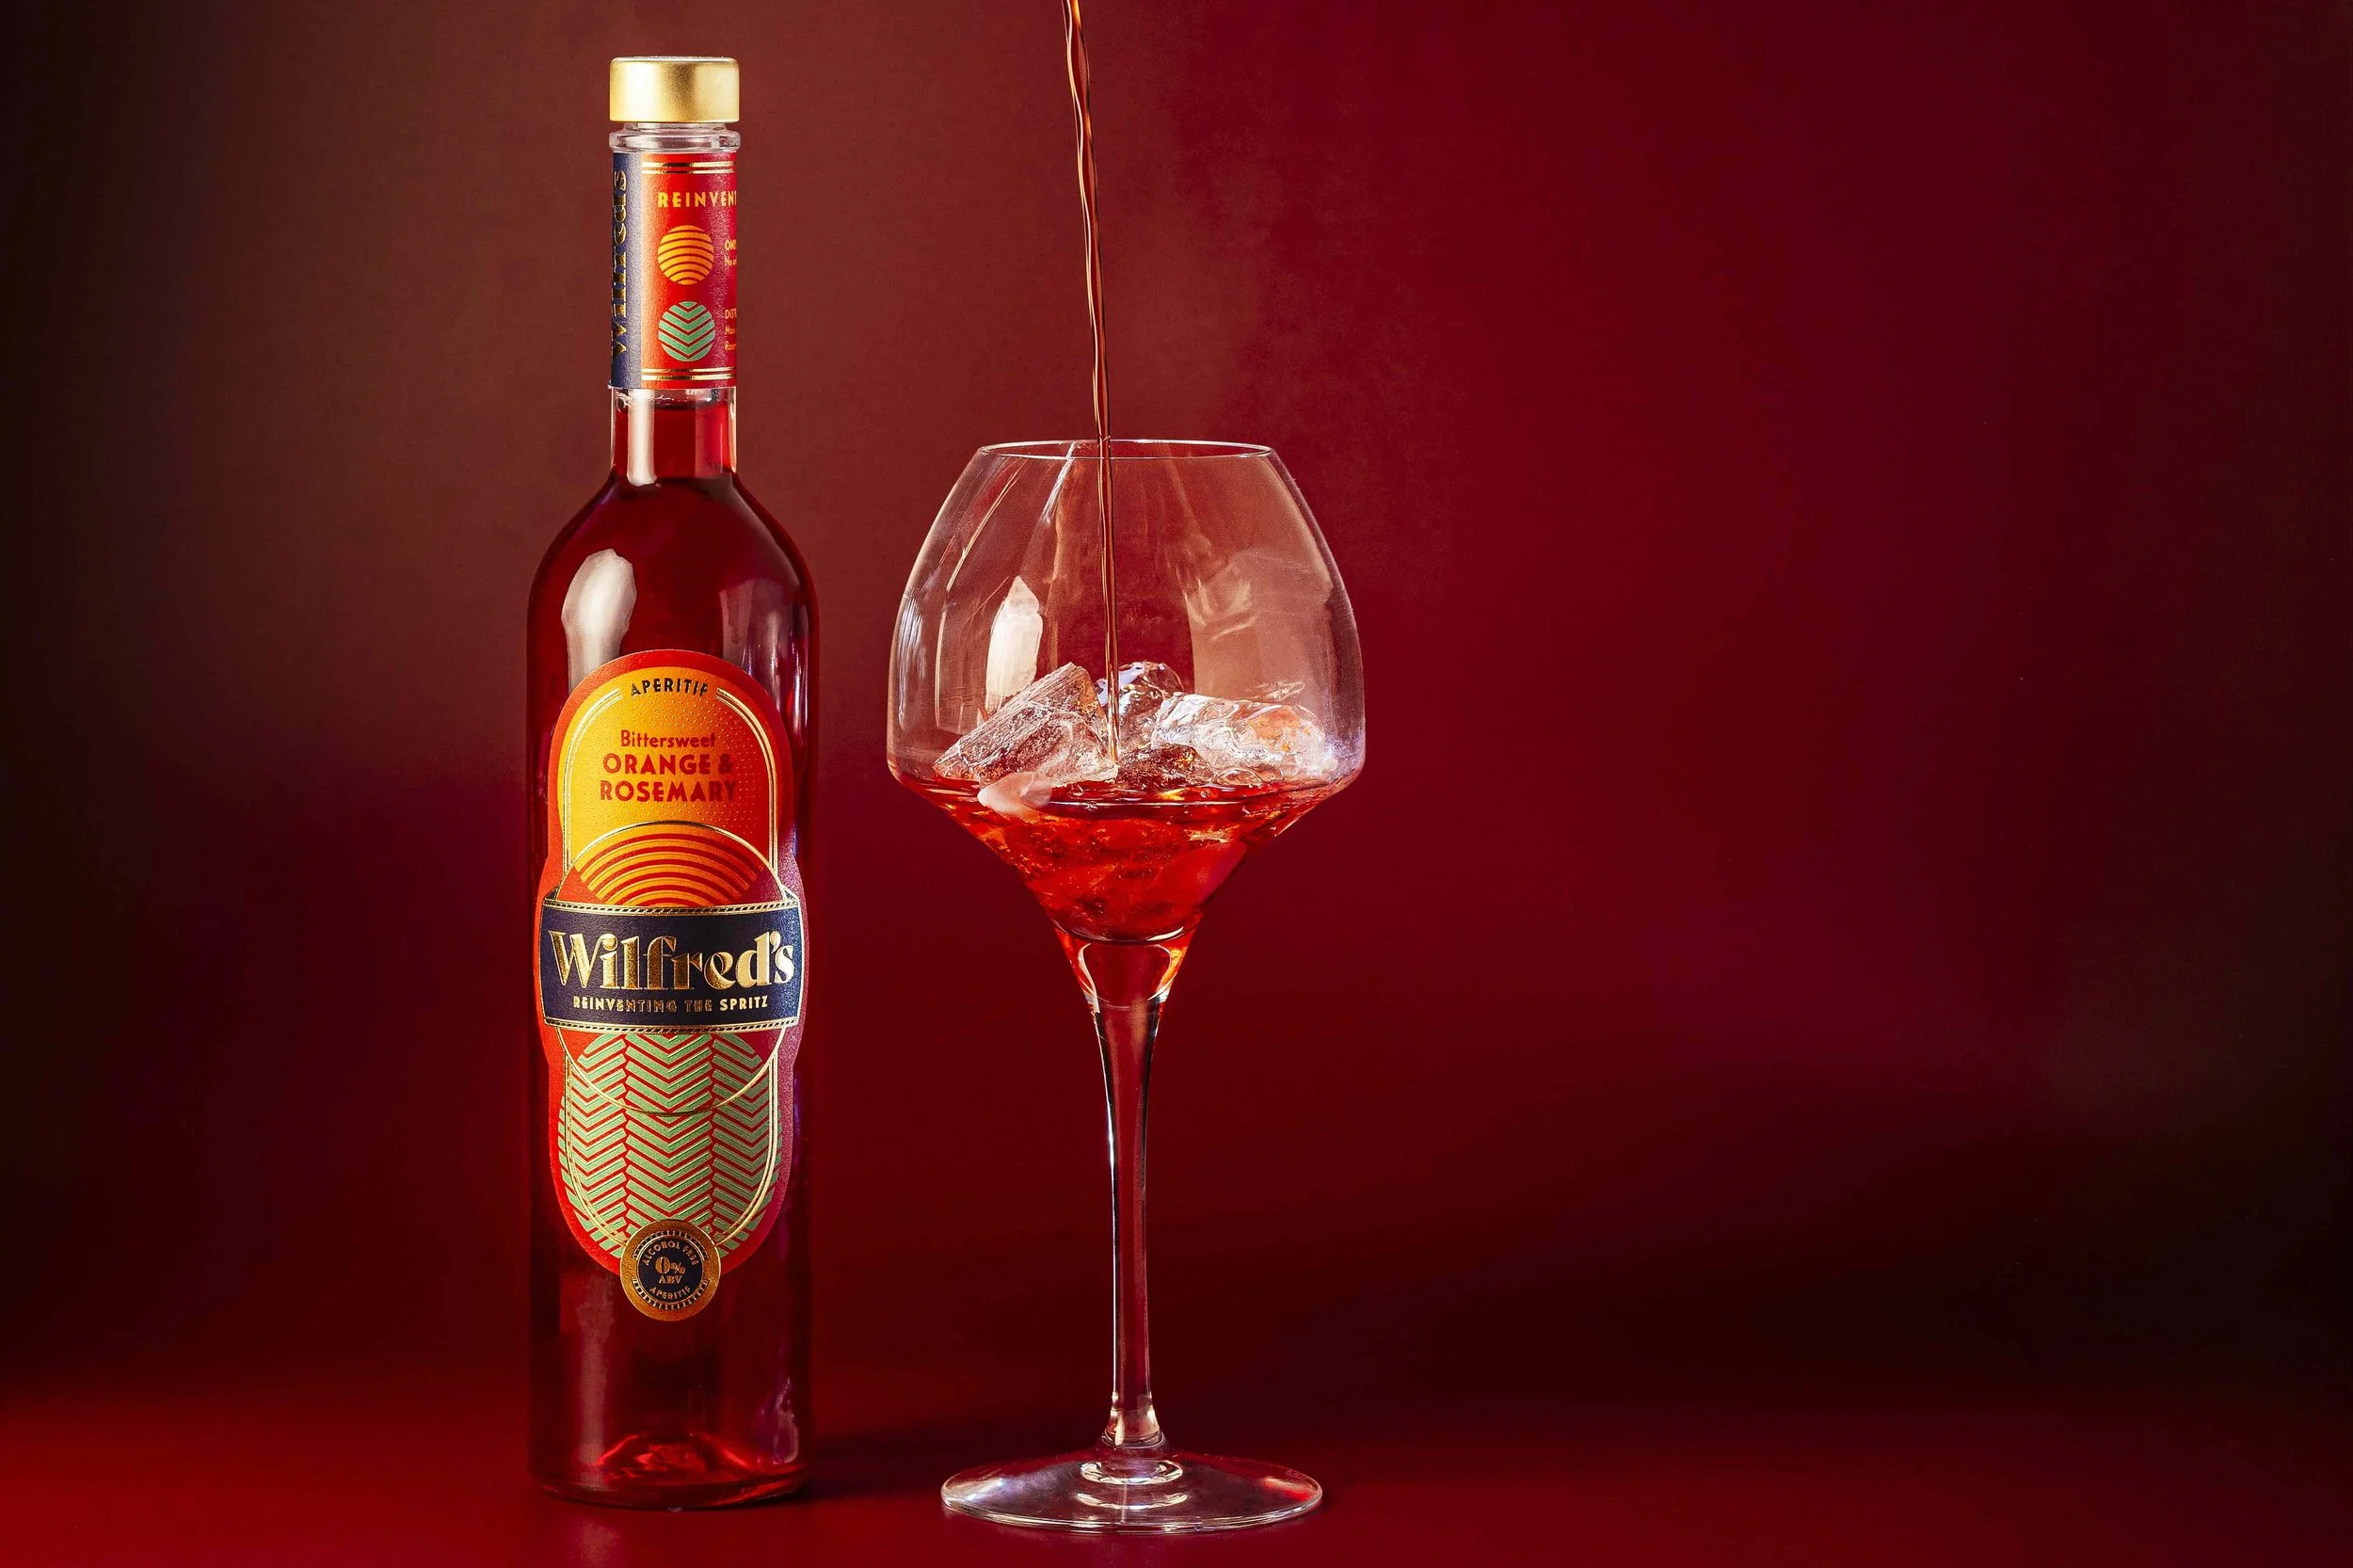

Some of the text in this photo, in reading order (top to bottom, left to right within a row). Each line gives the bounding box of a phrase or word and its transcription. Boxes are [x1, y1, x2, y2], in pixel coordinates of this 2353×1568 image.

[632, 678, 709, 696] APERITIF
[621, 729, 716, 747] Bittersweet
[603, 753, 734, 776] ORANGE &
[600, 780, 737, 802] ROSEMARY
[549, 931, 795, 990] Wilfred's
[573, 995, 768, 1014] REINVENTING THE SPRITZ
[642, 1241, 699, 1266] ALCOHOL FREE
[655, 1256, 686, 1275] 0%
[659, 1274, 683, 1285] ABV
[649, 1286, 691, 1300] APERITIF
